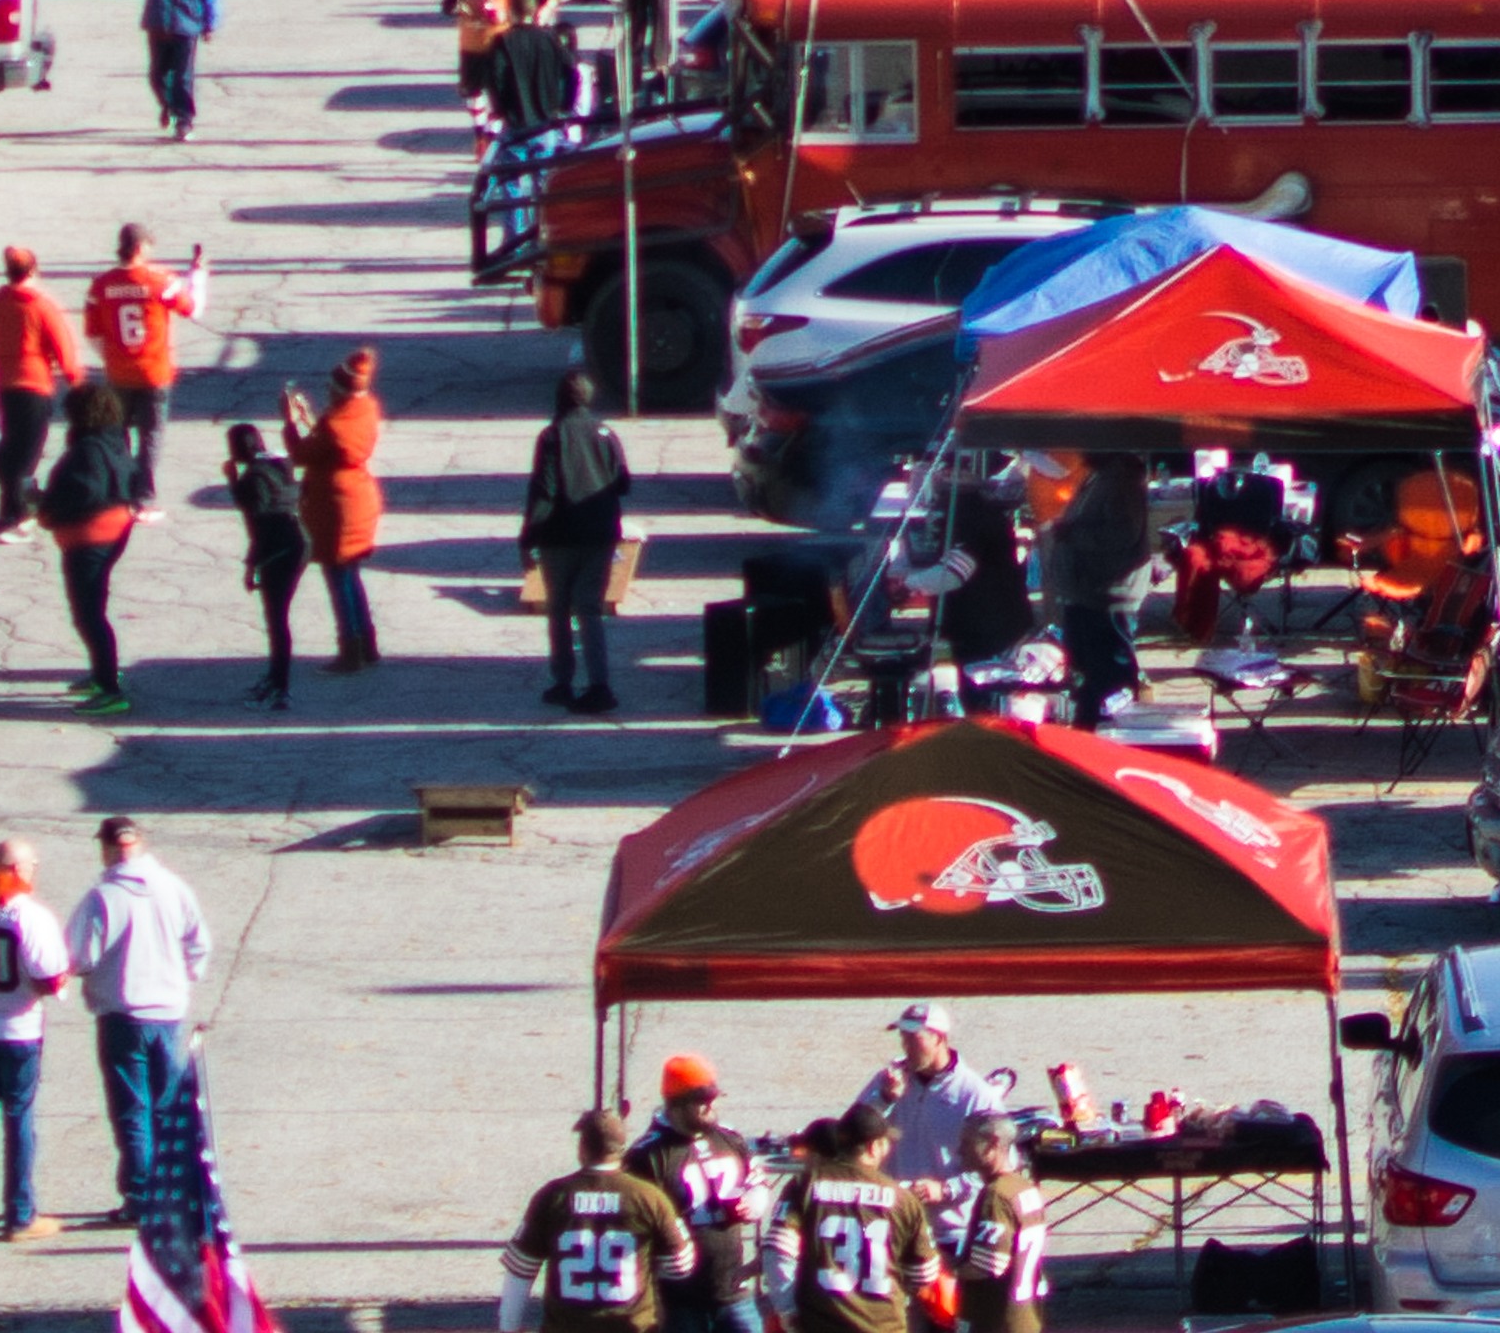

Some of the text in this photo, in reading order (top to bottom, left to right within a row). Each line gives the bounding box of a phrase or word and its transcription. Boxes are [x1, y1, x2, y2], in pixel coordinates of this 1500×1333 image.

[118, 304, 146, 347] 6
[557, 1228, 637, 1302] 29
[817, 1215, 892, 1295] 31
